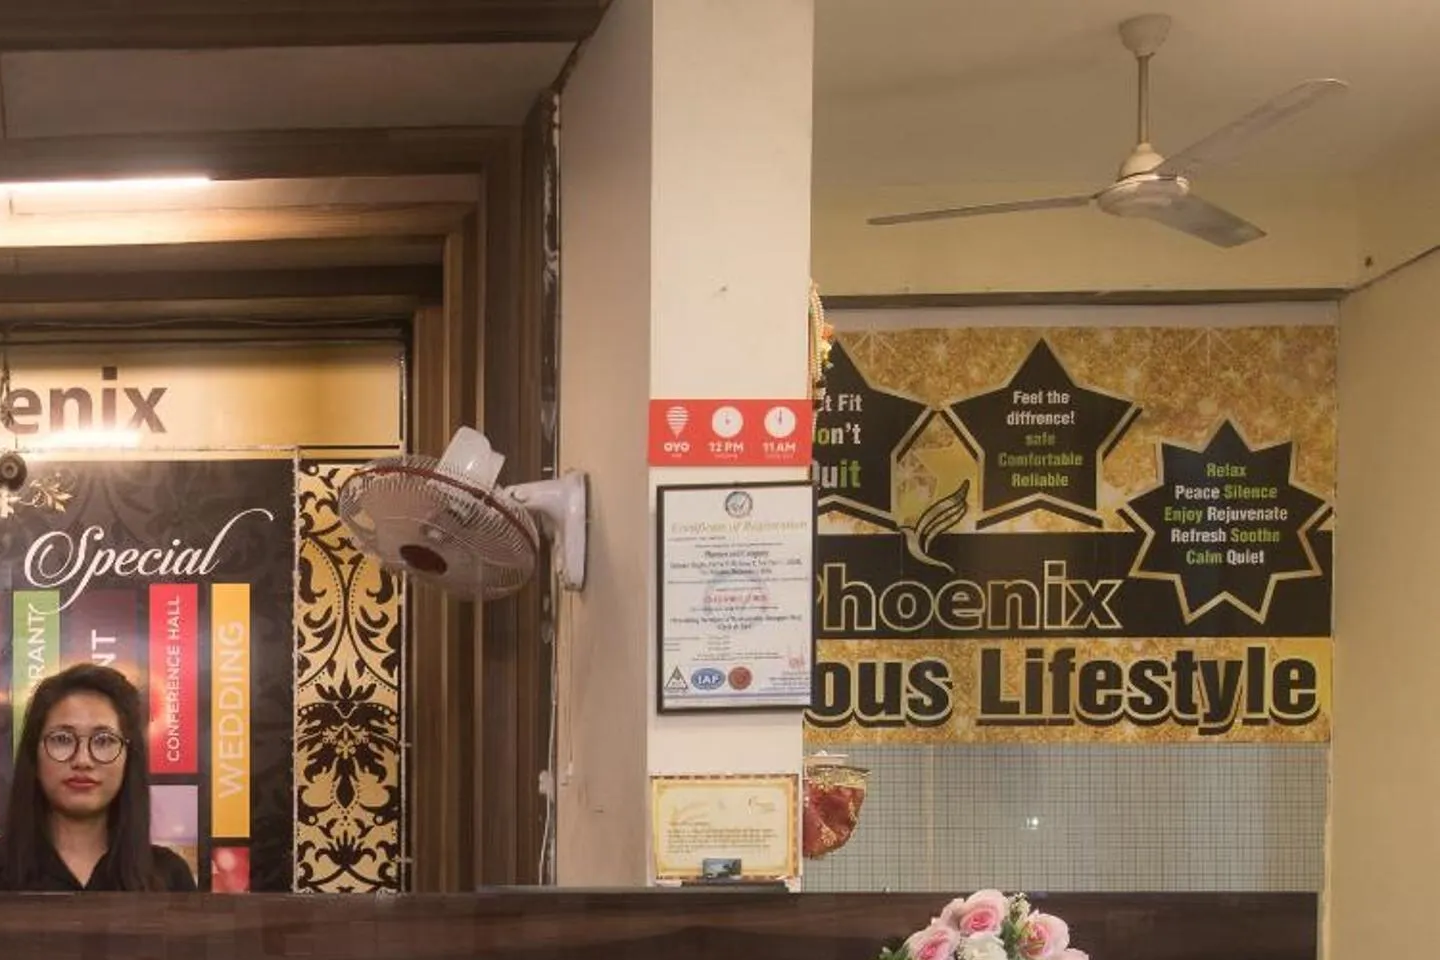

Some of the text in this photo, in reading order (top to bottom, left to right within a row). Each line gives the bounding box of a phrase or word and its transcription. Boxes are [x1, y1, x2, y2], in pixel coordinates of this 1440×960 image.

[838, 393, 863, 412] Fit
[1013, 390, 1070, 404] Feel the
[1006, 411, 1076, 425] diffrence!
[812, 422, 861, 445] on't
[663, 442, 690, 453] OYO
[708, 442, 744, 453] 12 PM
[763, 442, 796, 453] 11 AM
[998, 452, 1084, 467] Comfortable
[1206, 462, 1247, 477] Relax
[1011, 473, 1069, 487] Reliable
[1175, 484, 1278, 500] Peace Silence
[1164, 506, 1288, 524] Enjoy Rejuvenate
[1171, 528, 1227, 542] Refresh
[24, 508, 274, 615] Special
[1186, 549, 1264, 565] Calm Quiet
[817, 560, 1124, 631] hoenix
[166, 596, 181, 762] CONFERENCE HALL
[814, 645, 1320, 734] ous Lifestyle
[217, 621, 245, 799] WEDDING
